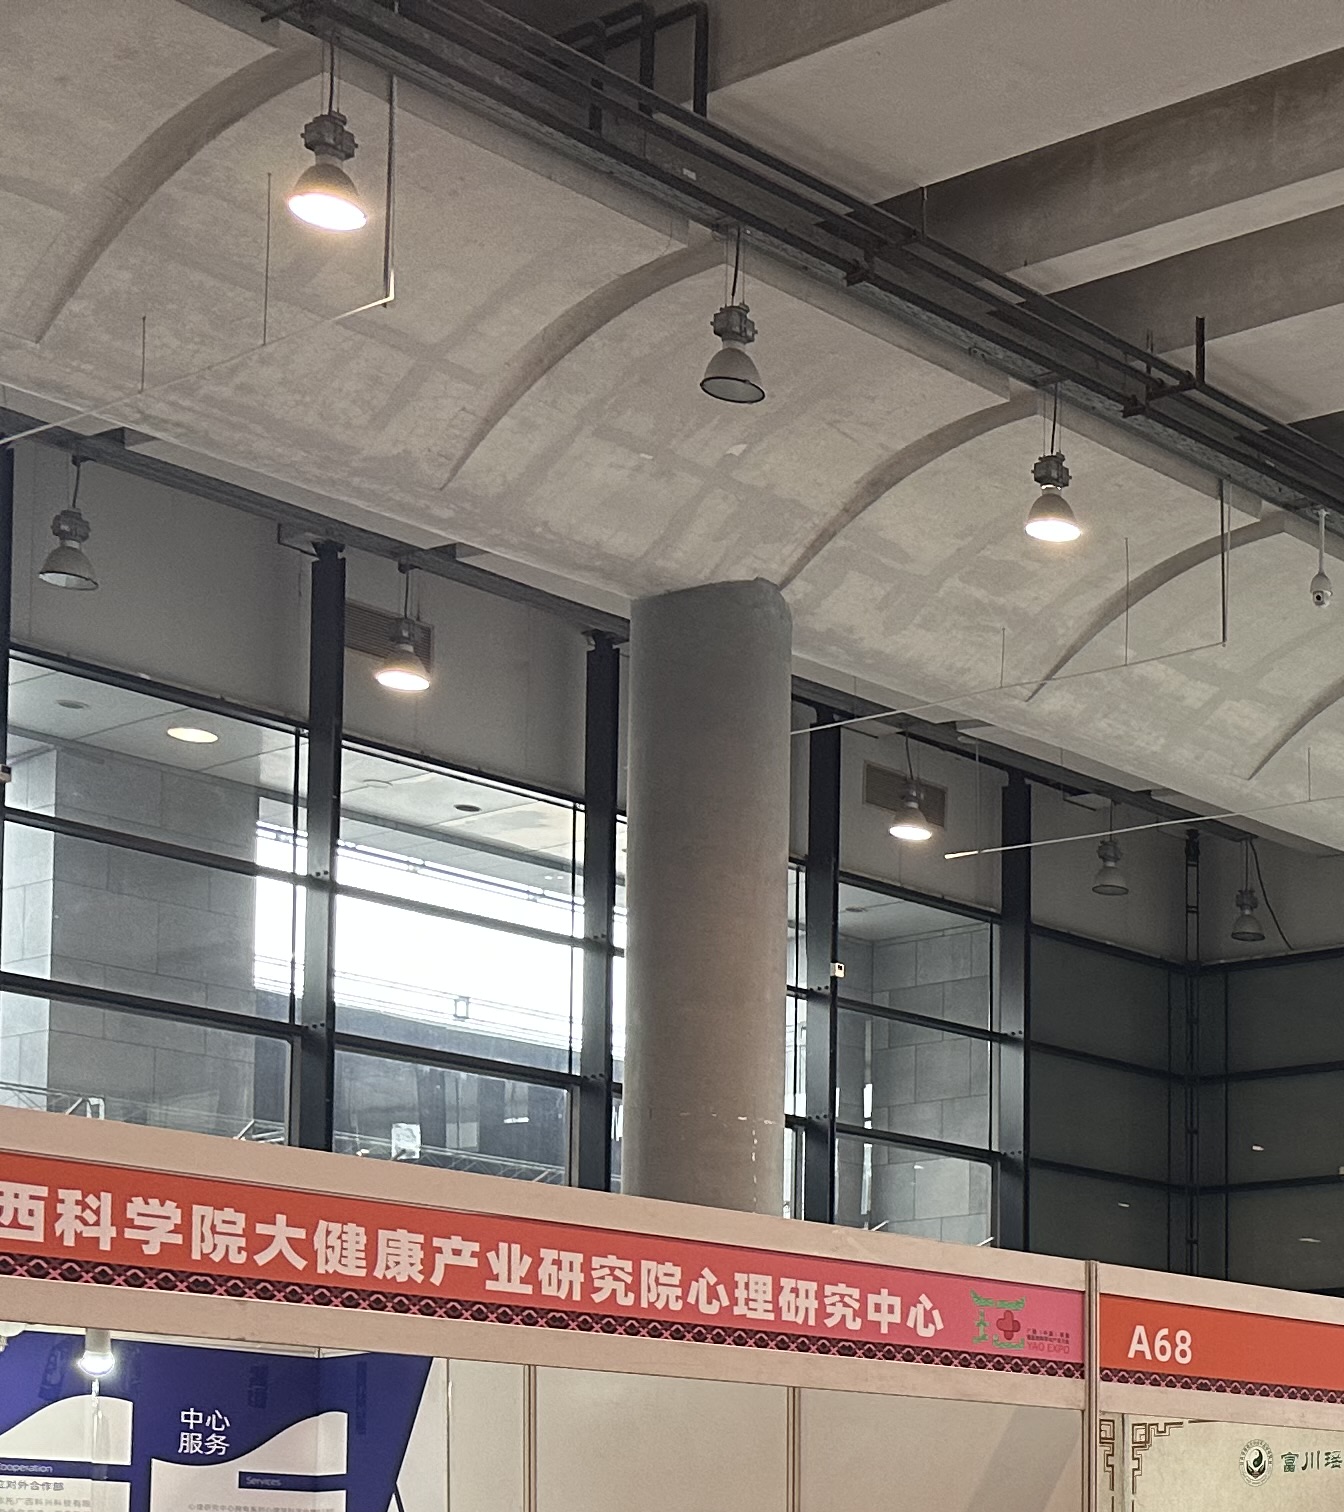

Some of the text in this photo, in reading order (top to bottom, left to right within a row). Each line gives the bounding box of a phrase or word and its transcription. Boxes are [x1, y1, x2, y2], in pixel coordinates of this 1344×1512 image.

[1128, 1325, 1194, 1366] A68
[180, 1408, 230, 1431] 中心
[178, 1432, 230, 1456] 服务
